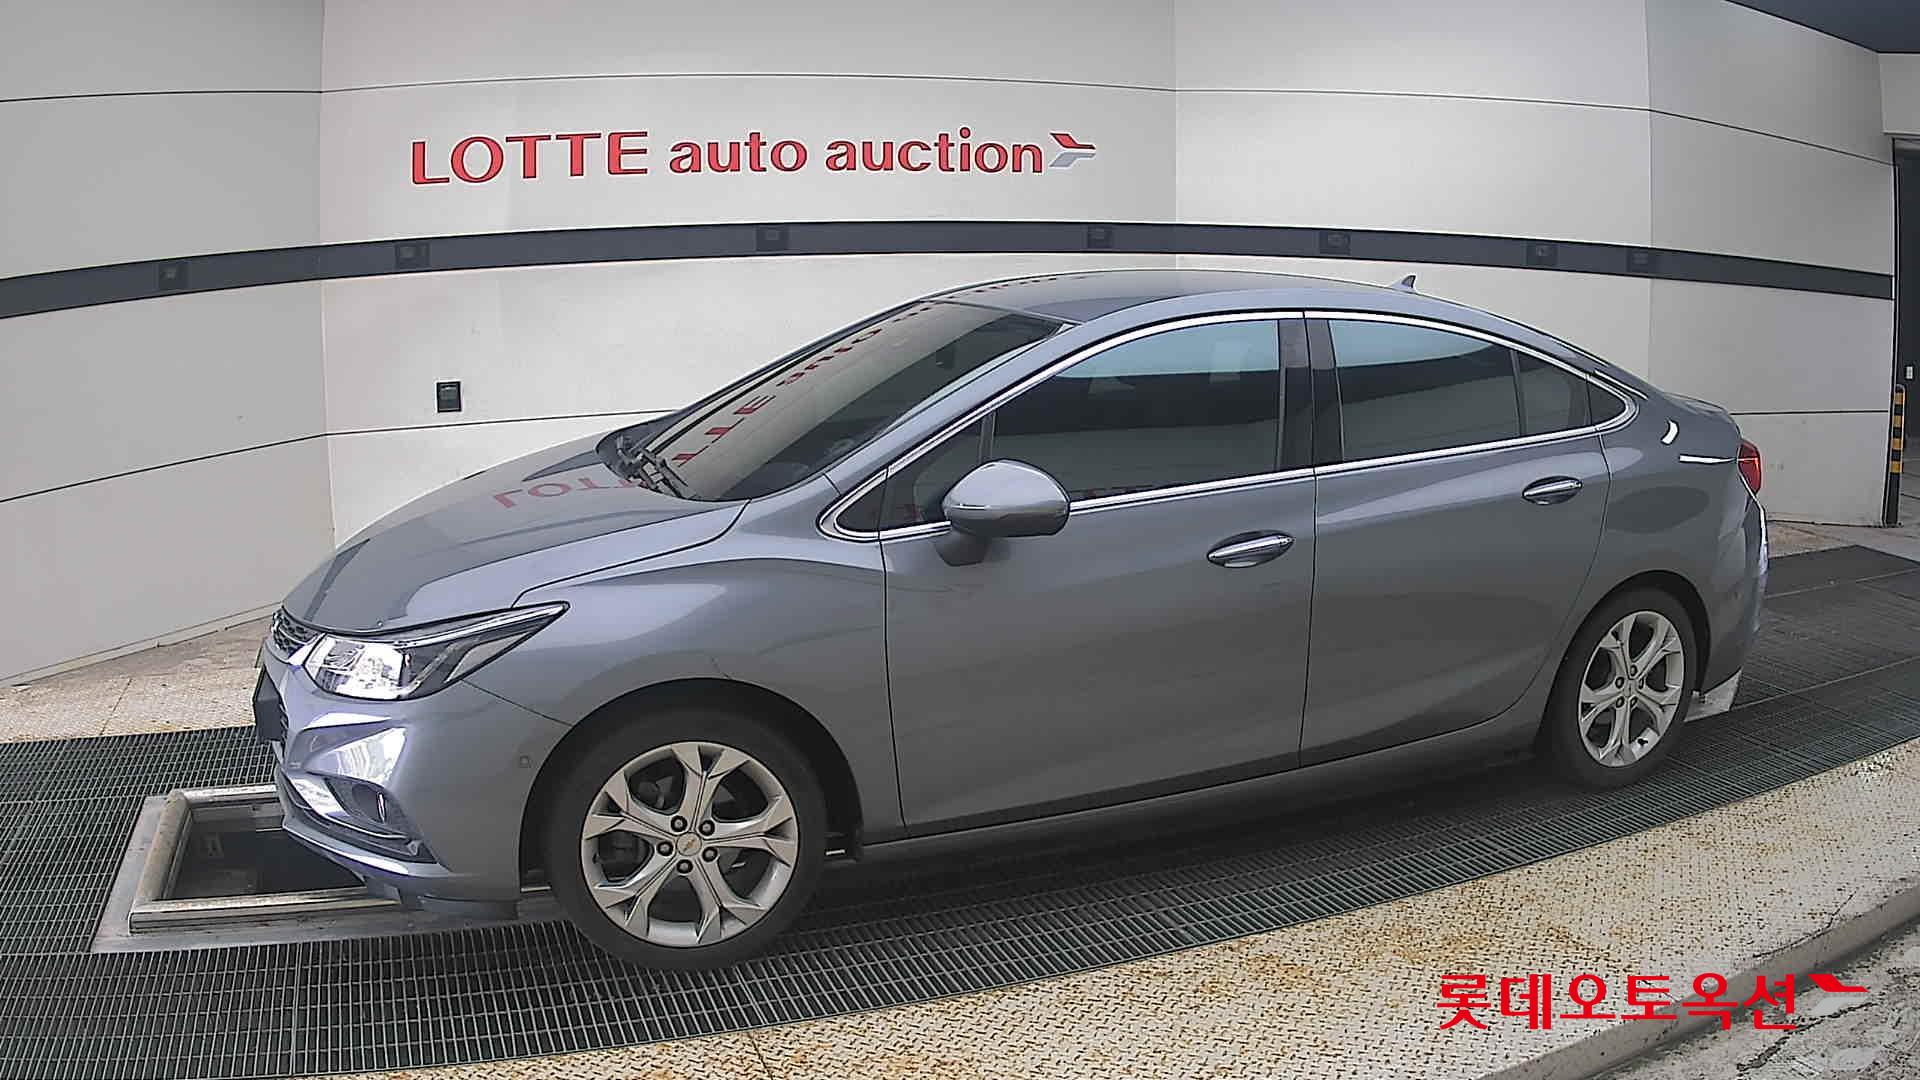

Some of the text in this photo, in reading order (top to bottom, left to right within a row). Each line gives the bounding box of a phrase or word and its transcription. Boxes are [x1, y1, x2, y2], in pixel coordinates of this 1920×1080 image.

[411, 127, 1043, 185] LOTTE auto auction
